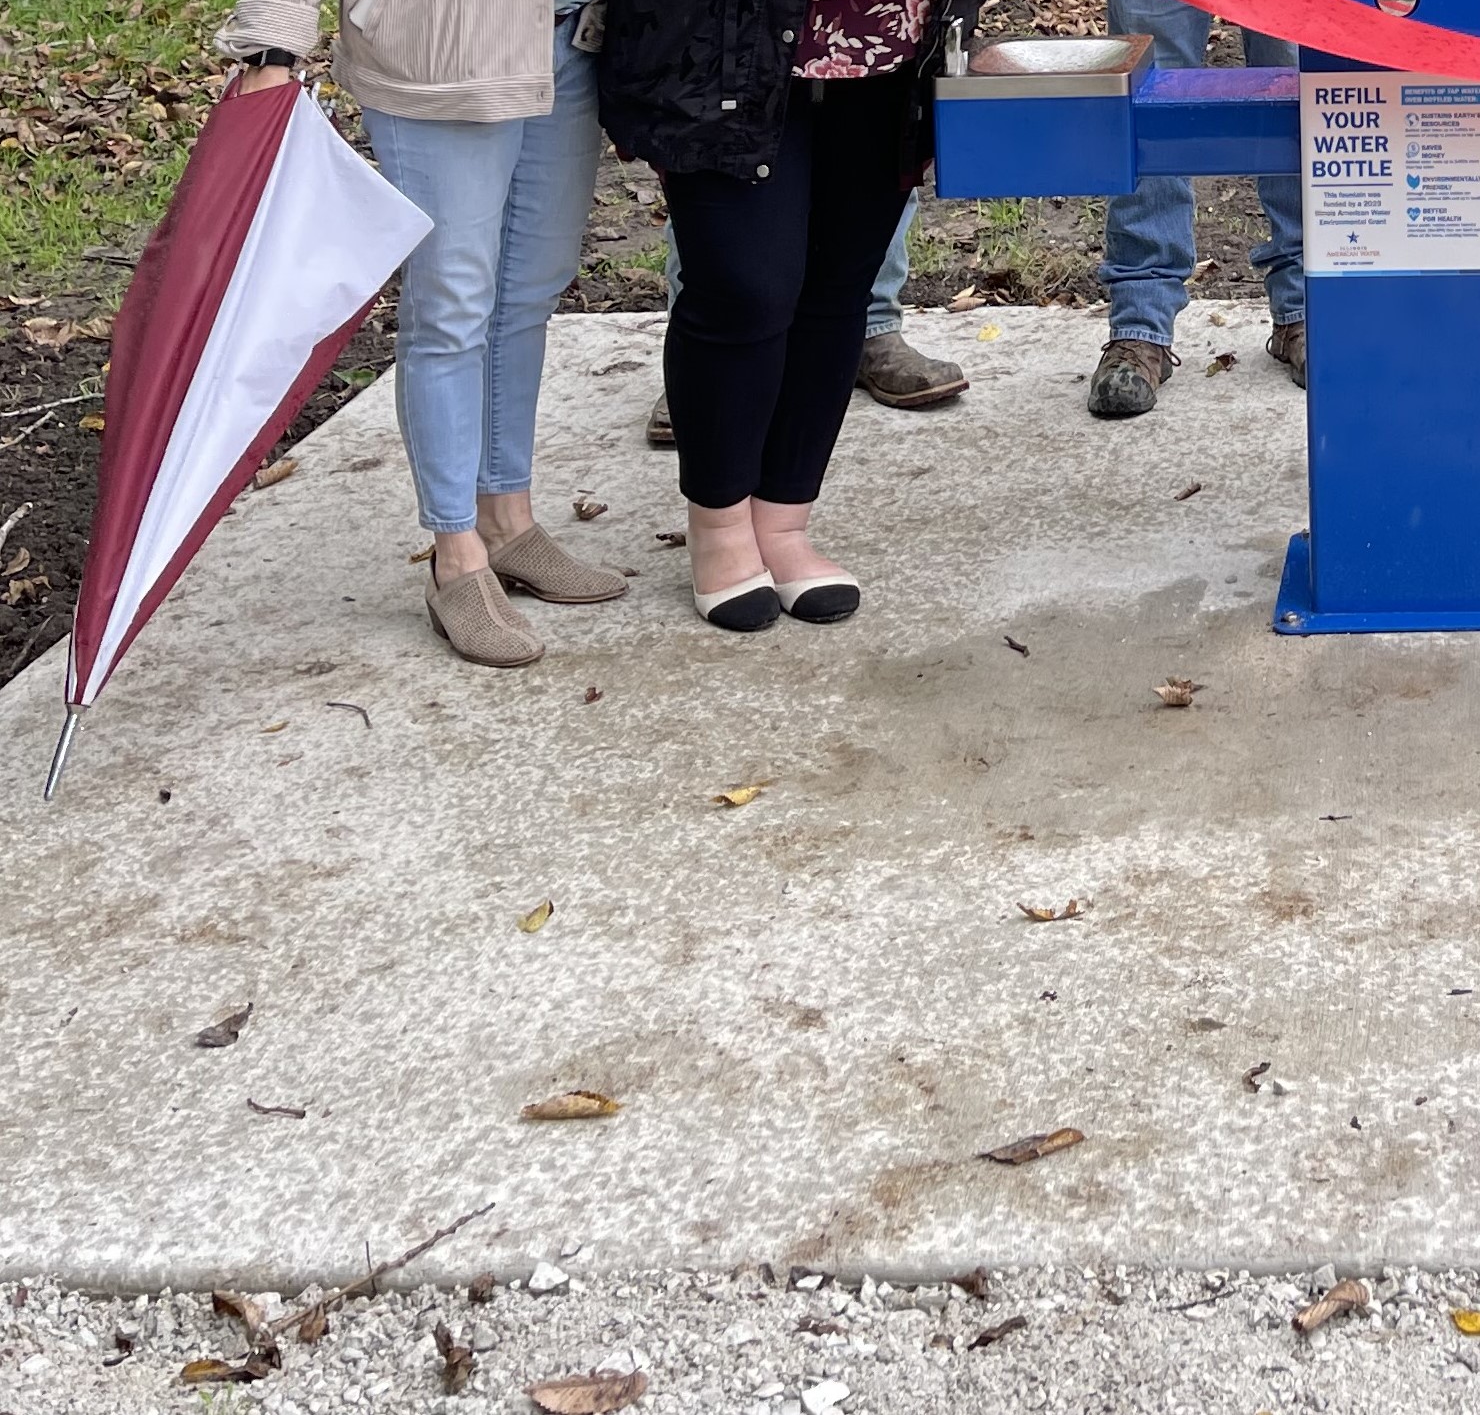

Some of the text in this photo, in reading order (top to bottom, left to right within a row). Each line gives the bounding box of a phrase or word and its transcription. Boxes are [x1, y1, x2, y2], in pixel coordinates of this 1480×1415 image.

[1315, 87, 1387, 105] REFILL
[1321, 111, 1380, 129] YOUR
[1313, 135, 1389, 154] WATER
[1312, 159, 1393, 178] BOTTLE
[1323, 191, 1338, 199] This
[1348, 200, 1356, 209] by
